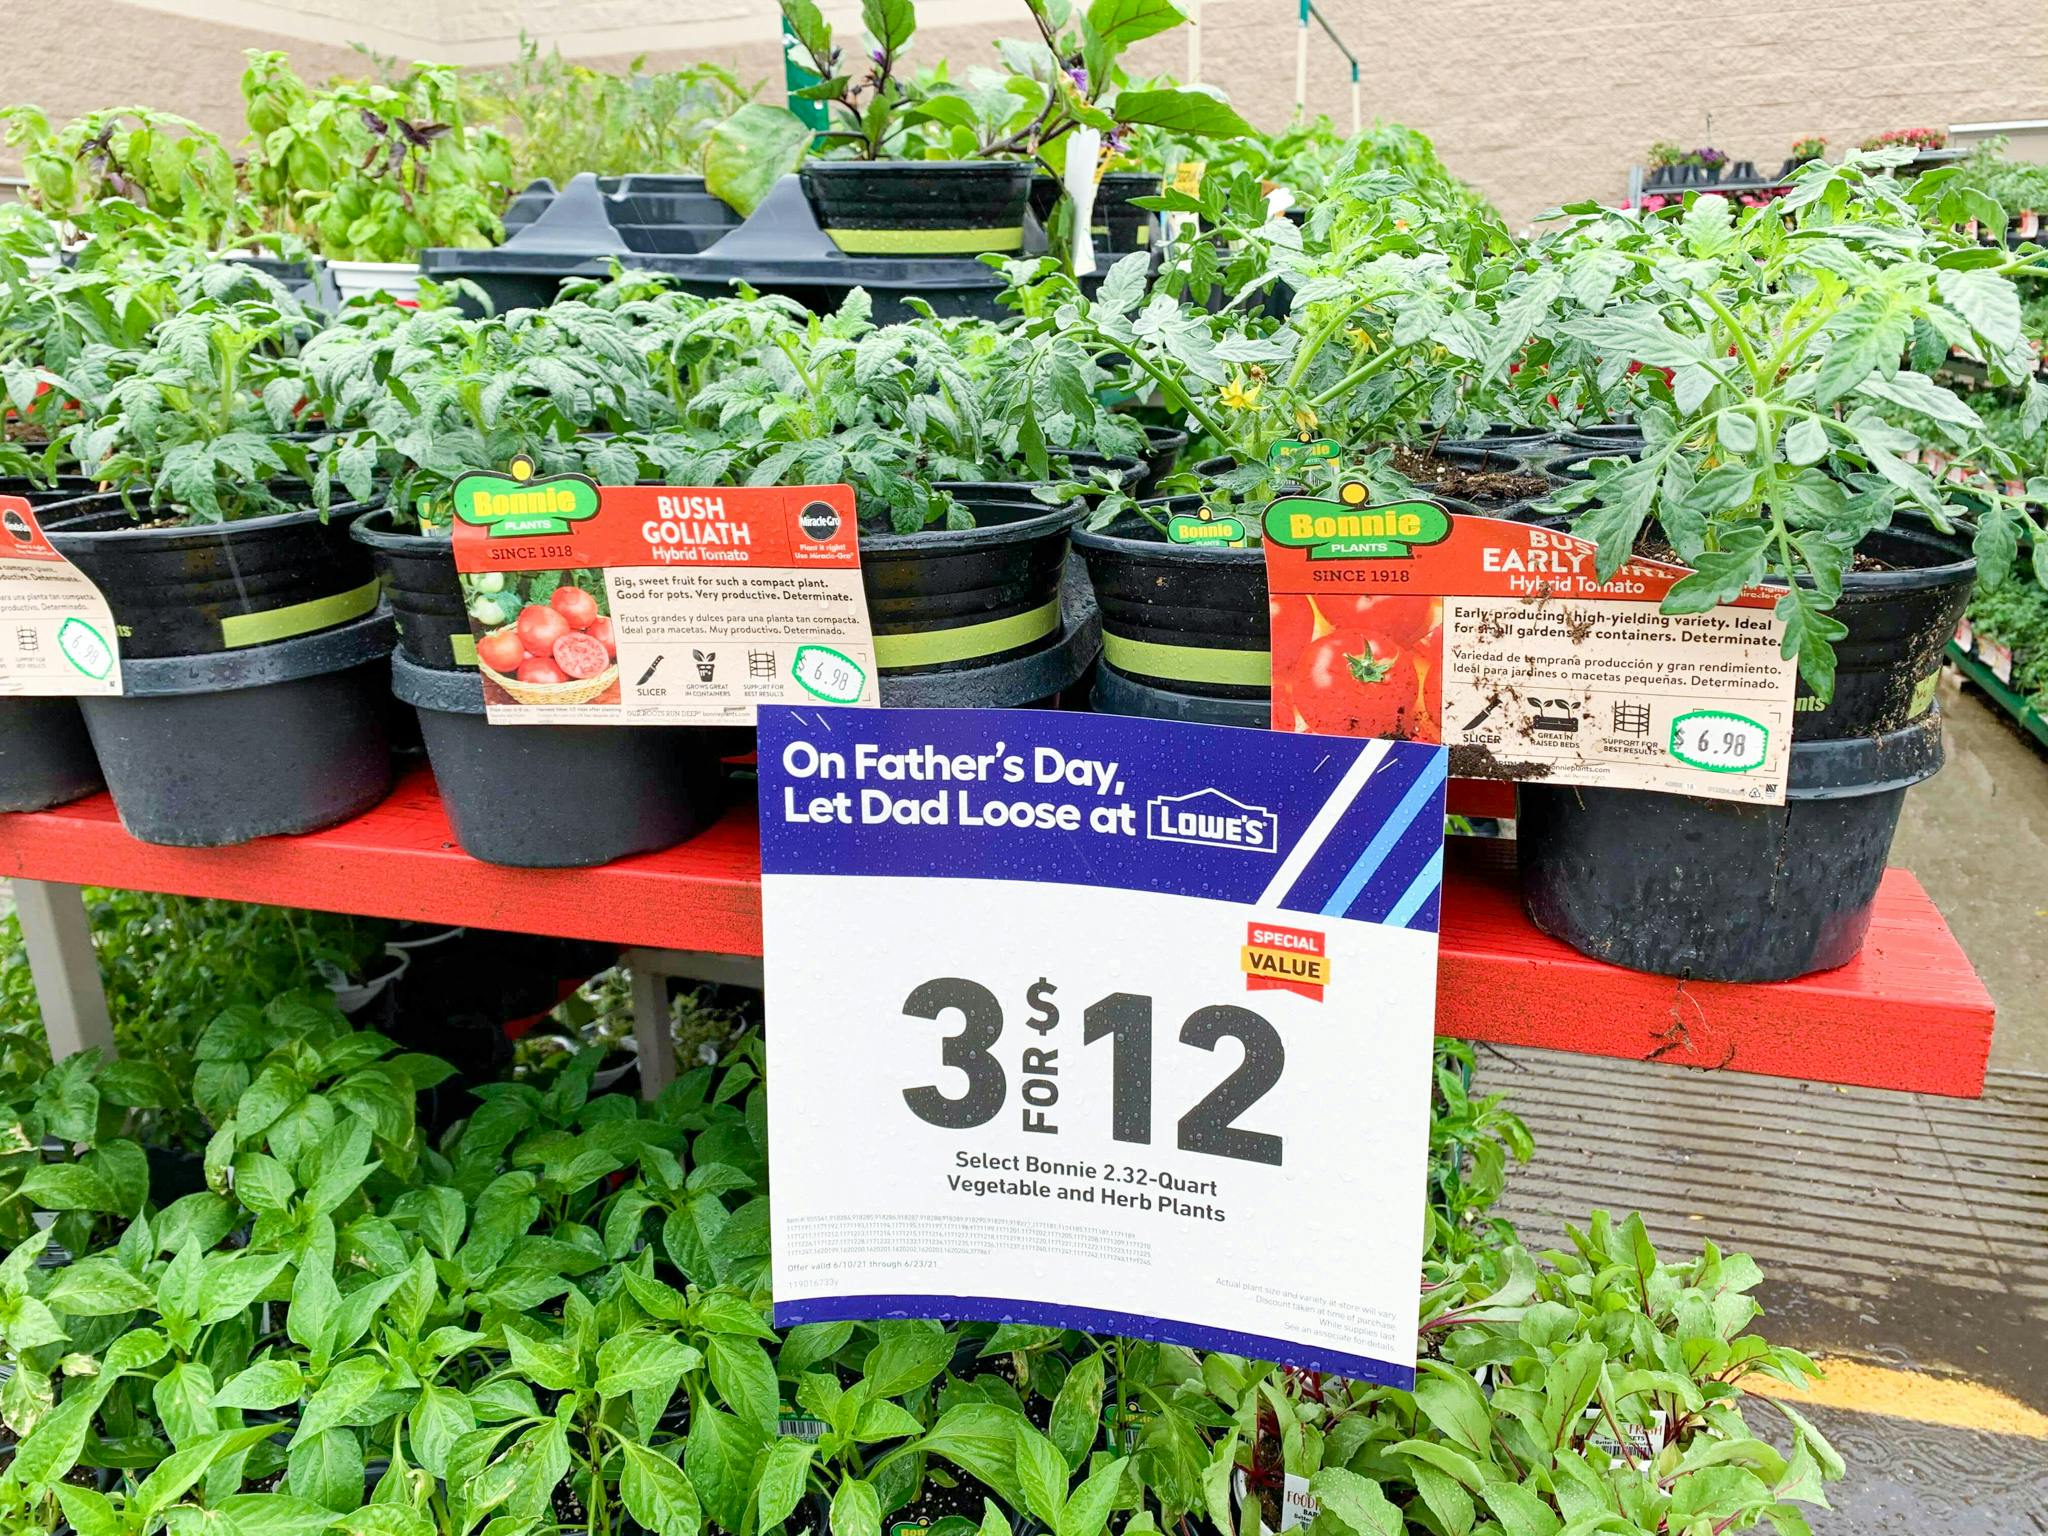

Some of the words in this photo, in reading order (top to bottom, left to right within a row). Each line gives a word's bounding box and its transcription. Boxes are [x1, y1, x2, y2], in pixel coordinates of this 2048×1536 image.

[473, 487, 576, 517] Bonnie
[657, 496, 726, 520] BUSH
[504, 519, 552, 530] PLANTS
[799, 514, 840, 528] Miracle-Gro
[1178, 522, 1232, 539] Bonnie
[1289, 510, 1421, 539] Bonnie
[642, 520, 751, 545] GOLIATH
[492, 547, 537, 560] SINCE
[541, 545, 573, 558] 1918
[1331, 543, 1388, 553] PLANTS
[1528, 530, 1598, 556] BUS
[652, 546, 697, 564] Hybrid
[699, 547, 749, 562] Tomato
[1483, 548, 1586, 574] EARLY
[1615, 563, 1674, 579] IRL
[615, 577, 636, 588] Big,
[639, 577, 669, 586] sweet
[672, 576, 695, 586] fruit
[698, 576, 713, 586] for
[716, 577, 739, 586] such
[751, 578, 795, 589] compact
[798, 579, 828, 590] plant.
[1312, 570, 1366, 582] SINCE
[1371, 570, 1410, 582] 1918
[1509, 575, 1571, 594] Hybrid
[1577, 577, 1645, 594] Tomato
[616, 590, 645, 600] Good
[648, 590, 664, 600] for
[667, 591, 693, 602] pots.
[695, 590, 719, 602] Very
[722, 590, 780, 603] productive.
[783, 591, 853, 602] Determinate.
[620, 614, 648, 623] Frutos
[651, 614, 687, 625] grandes
[697, 614, 724, 623] dulces
[727, 616, 746, 625] para
[766, 614, 793, 625] planta
[796, 615, 811, 623] tan
[813, 616, 859, 626] compacta.
[1573, 610, 1670, 629] high-yielding
[1674, 615, 1730, 631] variety.
[1735, 617, 1772, 631] Ideal
[622, 626, 643, 634] Ideal
[646, 627, 665, 636] para
[668, 626, 706, 634] macetas.
[709, 626, 728, 636] Muy
[730, 626, 781, 636] productivo.
[784, 626, 845, 636] Determinado.
[1454, 622, 1475, 634] for
[1517, 625, 1572, 640] gardens
[1595, 627, 1677, 642] containers.
[1681, 631, 1782, 647] Determinate.
[1453, 650, 1503, 662] Variedad
[1507, 653, 1521, 662] de
[1524, 655, 1581, 668] temprana
[1584, 656, 1653, 672] producción
[1657, 664, 1664, 673] y
[1667, 664, 1696, 674] gran
[1699, 663, 1782, 676] rendimiento.
[814, 660, 850, 692] 6.98
[1453, 662, 1480, 674] Ideal
[1483, 666, 1508, 678] para
[1511, 667, 1557, 680] jardines
[1571, 671, 1621, 682] macetas
[1624, 672, 1687, 687] pequeñas.
[1691, 676, 1779, 691] Determinado.
[637, 687, 667, 697] SLICER
[1795, 696, 1826, 711] nts
[1463, 734, 1501, 744] SLICER
[1537, 732, 1562, 740] GREAT
[1564, 733, 1573, 741] IN
[1602, 737, 1639, 747] SUPPORT
[1697, 730, 1746, 757] 6.98
[1624, 747, 1657, 755] RESULTS
[782, 742, 842, 780] On
[855, 742, 1025, 784] Father's
[1034, 748, 1127, 796] Day,
[1550, 763, 1611, 774] onnieplants.com
[784, 787, 852, 824] Let
[862, 790, 949, 826] Dad
[958, 791, 1080, 832] Loose
[1089, 802, 1136, 837] at
[1159, 804, 1268, 846] LOWE'S
[1253, 929, 1320, 953] SPECIAL
[1248, 953, 1323, 980] VALUE
[902, 977, 1007, 1130] 3
[1022, 1048, 1059, 1135] FOR
[955, 1151, 1020, 1172] Select
[1026, 1156, 1097, 1179] Bonnie
[1104, 1164, 1218, 1197] 2.32-Quart
[947, 1174, 1051, 1200] Vegetable
[1057, 1185, 1094, 1203] and
[1101, 1189, 1152, 1211] Herb
[1158, 1195, 1226, 1223] Plants
[787, 1263, 809, 1272] Offer
[811, 1262, 831, 1271] valid
[833, 1260, 866, 1270] 6/10/21
[869, 1260, 902, 1270] through
[905, 1260, 938, 1269] 6/23/21
[1216, 1277, 1241, 1288] Actual
[1242, 1282, 1263, 1293] plant
[1265, 1286, 1281, 1296] size
[1282, 1289, 1298, 1300] and
[1299, 1292, 1328, 1306] variety
[1339, 1300, 1360, 1311] store
[1362, 1304, 1377, 1315] will
[1256, 1295, 1291, 1310] Discount
[1292, 1302, 1315, 1313] taken
[1327, 1308, 1345, 1320] time
[1284, 1321, 1300, 1332] See
[1313, 1328, 1351, 1343] associate
[1354, 1335, 1366, 1345] for
[1319, 1318, 1342, 1329] While
[1344, 1323, 1378, 1338] supplies
[1628, 1423, 1663, 1436] FRSH
[1287, 1491, 1319, 1511] FOOD
